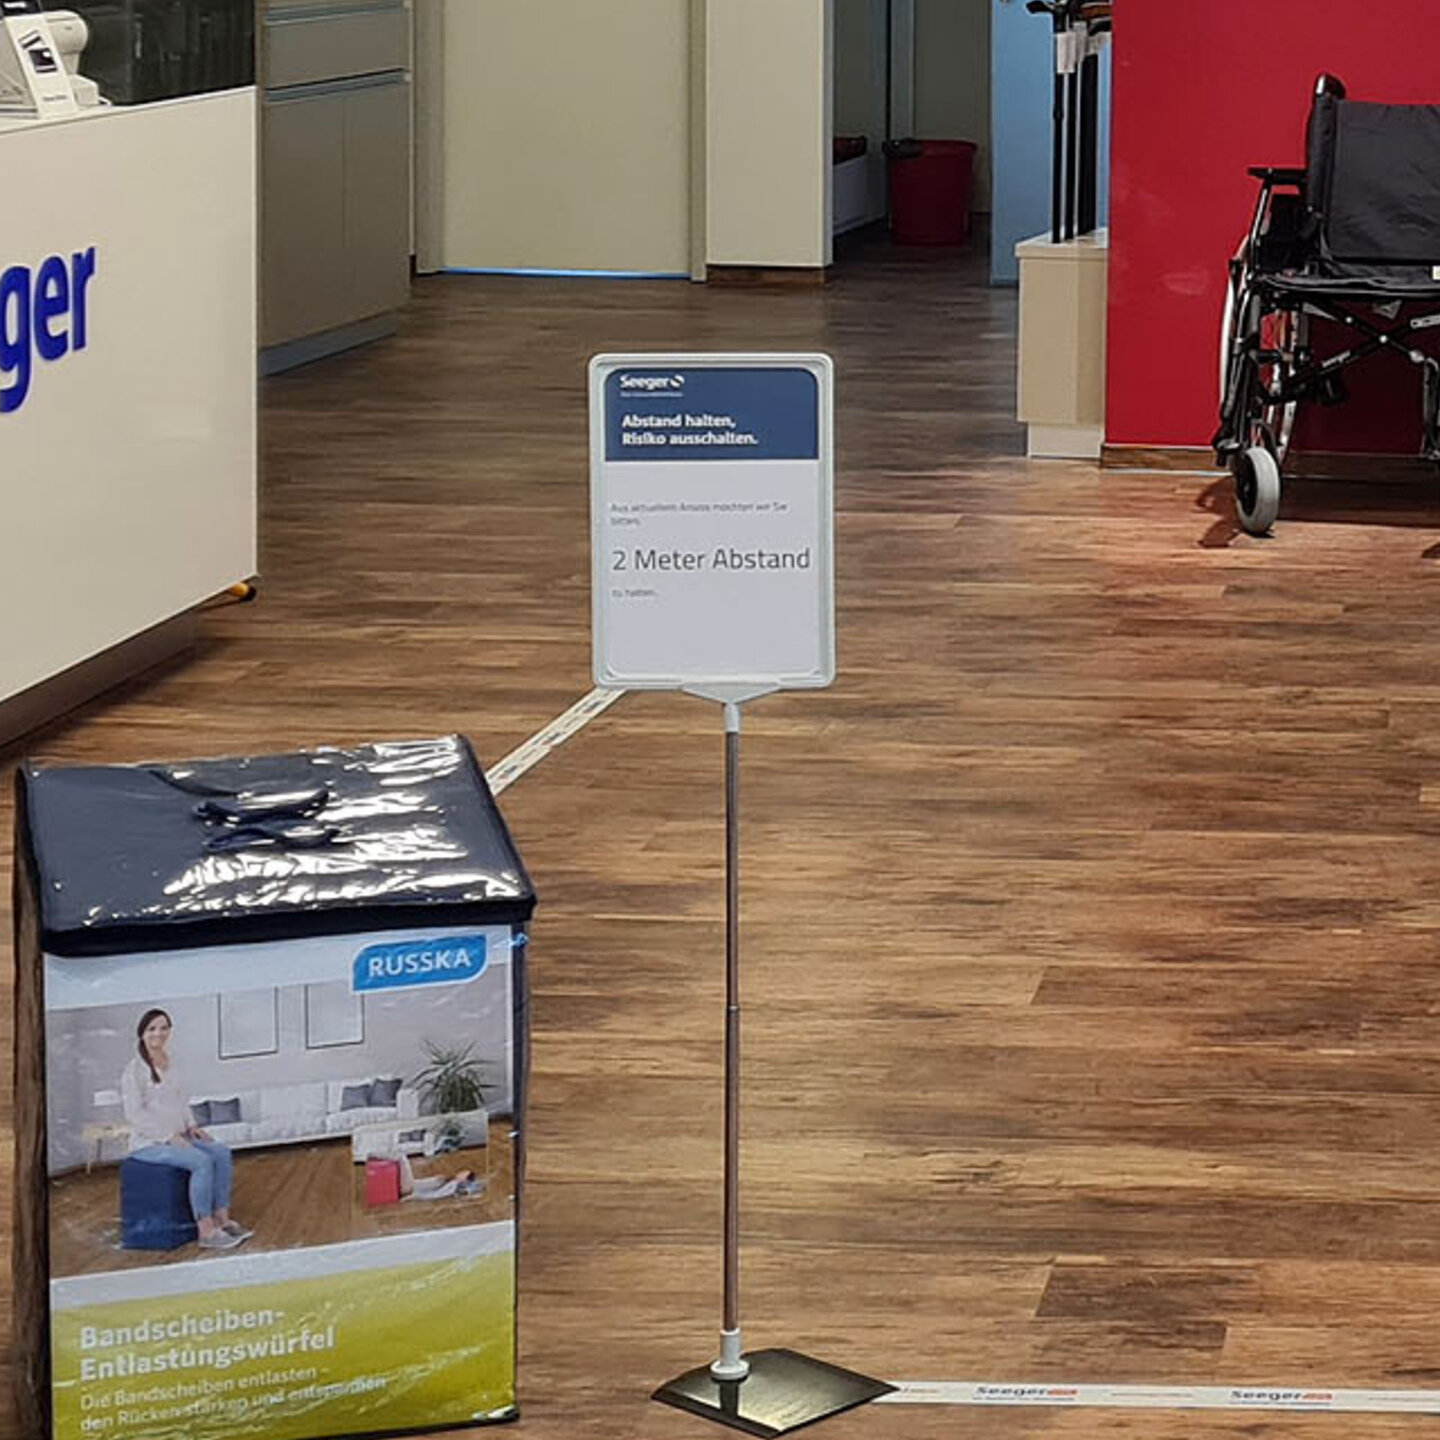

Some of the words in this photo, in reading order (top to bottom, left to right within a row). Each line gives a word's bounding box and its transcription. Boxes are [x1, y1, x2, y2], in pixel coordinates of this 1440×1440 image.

[620, 375, 668, 390] Seeger
[622, 414, 682, 428] Abstand
[685, 414, 736, 428] halten,
[622, 431, 666, 445] Risiko
[670, 431, 758, 445] ausschalten.
[613, 550, 627, 571] 2
[634, 549, 706, 571] Meter
[712, 547, 810, 570] Abstand
[367, 949, 471, 978] RUSSKA
[80, 1309, 285, 1350] Bandscheiben-
[80, 1325, 336, 1382] Entlastungswürfel
[115, 1380, 235, 1406] Bandscheiben
[239, 1367, 317, 1390] entlasten
